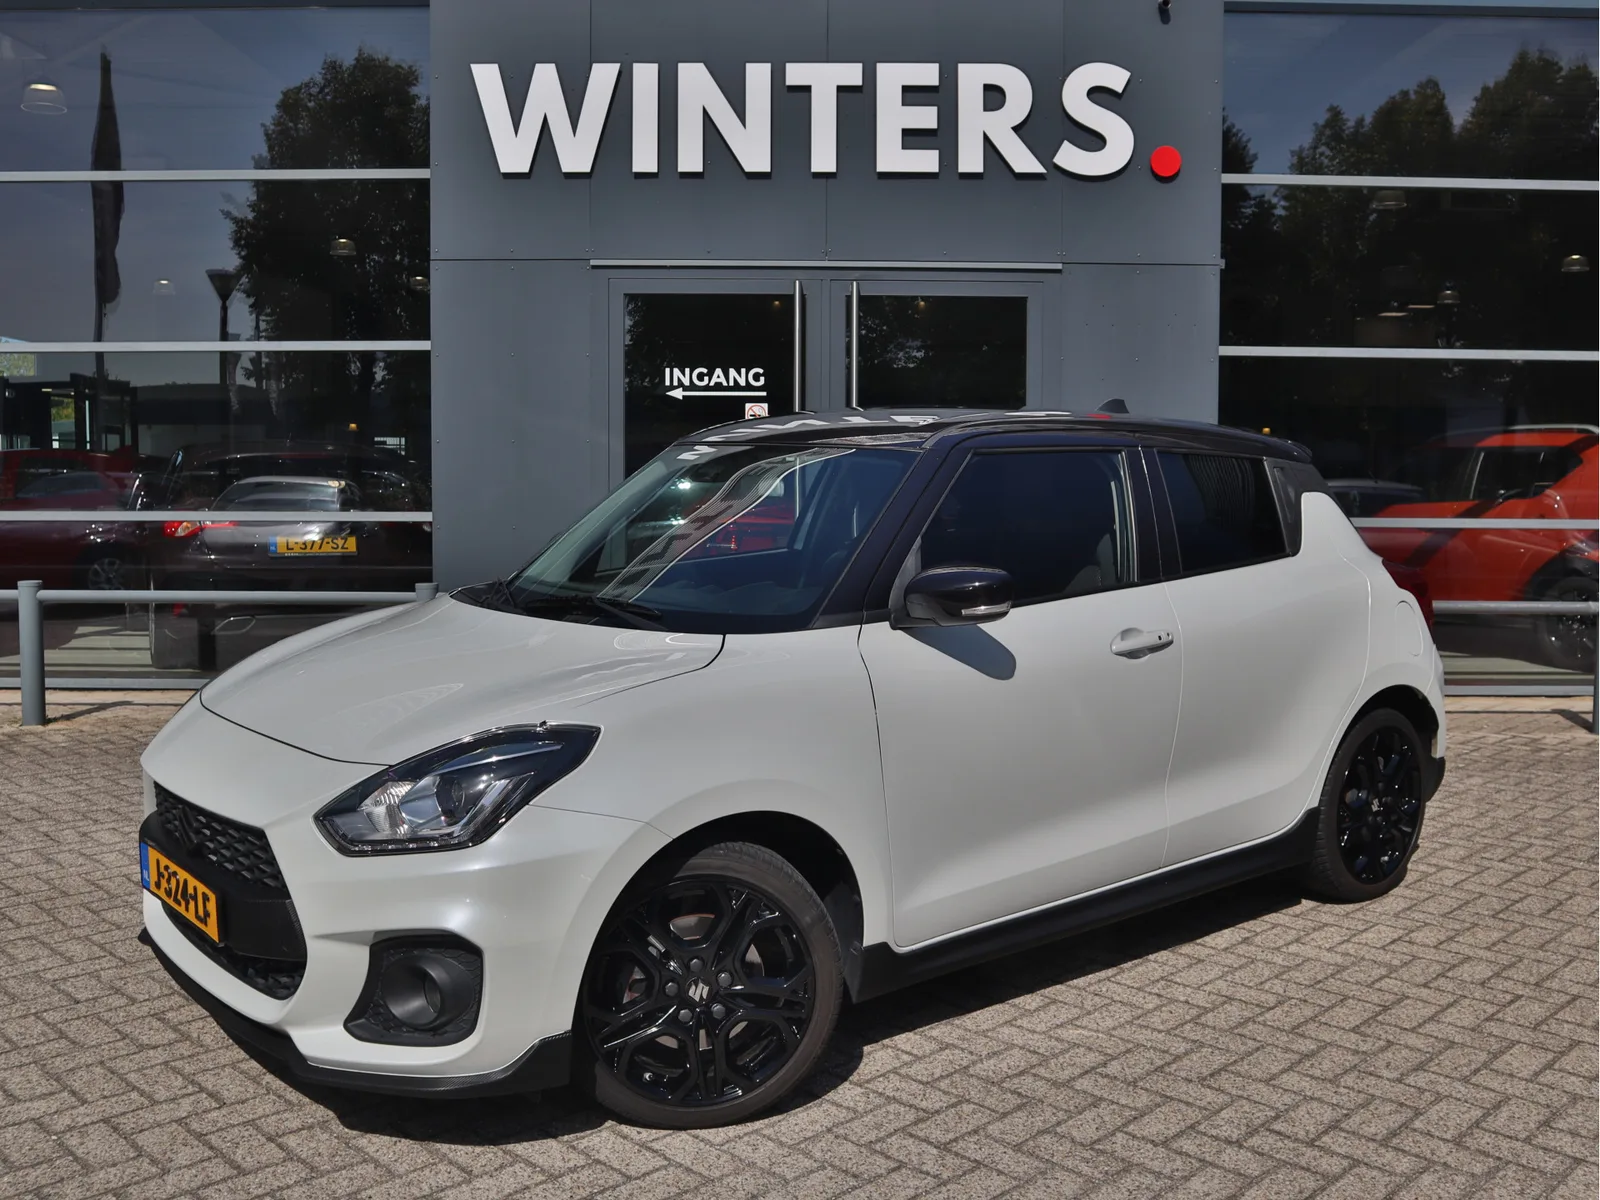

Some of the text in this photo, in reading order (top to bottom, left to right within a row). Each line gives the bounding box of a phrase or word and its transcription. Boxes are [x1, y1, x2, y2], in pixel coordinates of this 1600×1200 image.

[470, 62, 1182, 178] WINTERS.
[664, 367, 765, 387] INGANG
[286, 537, 349, 551] L-377-SZ
[154, 858, 211, 928] J-324-LF
